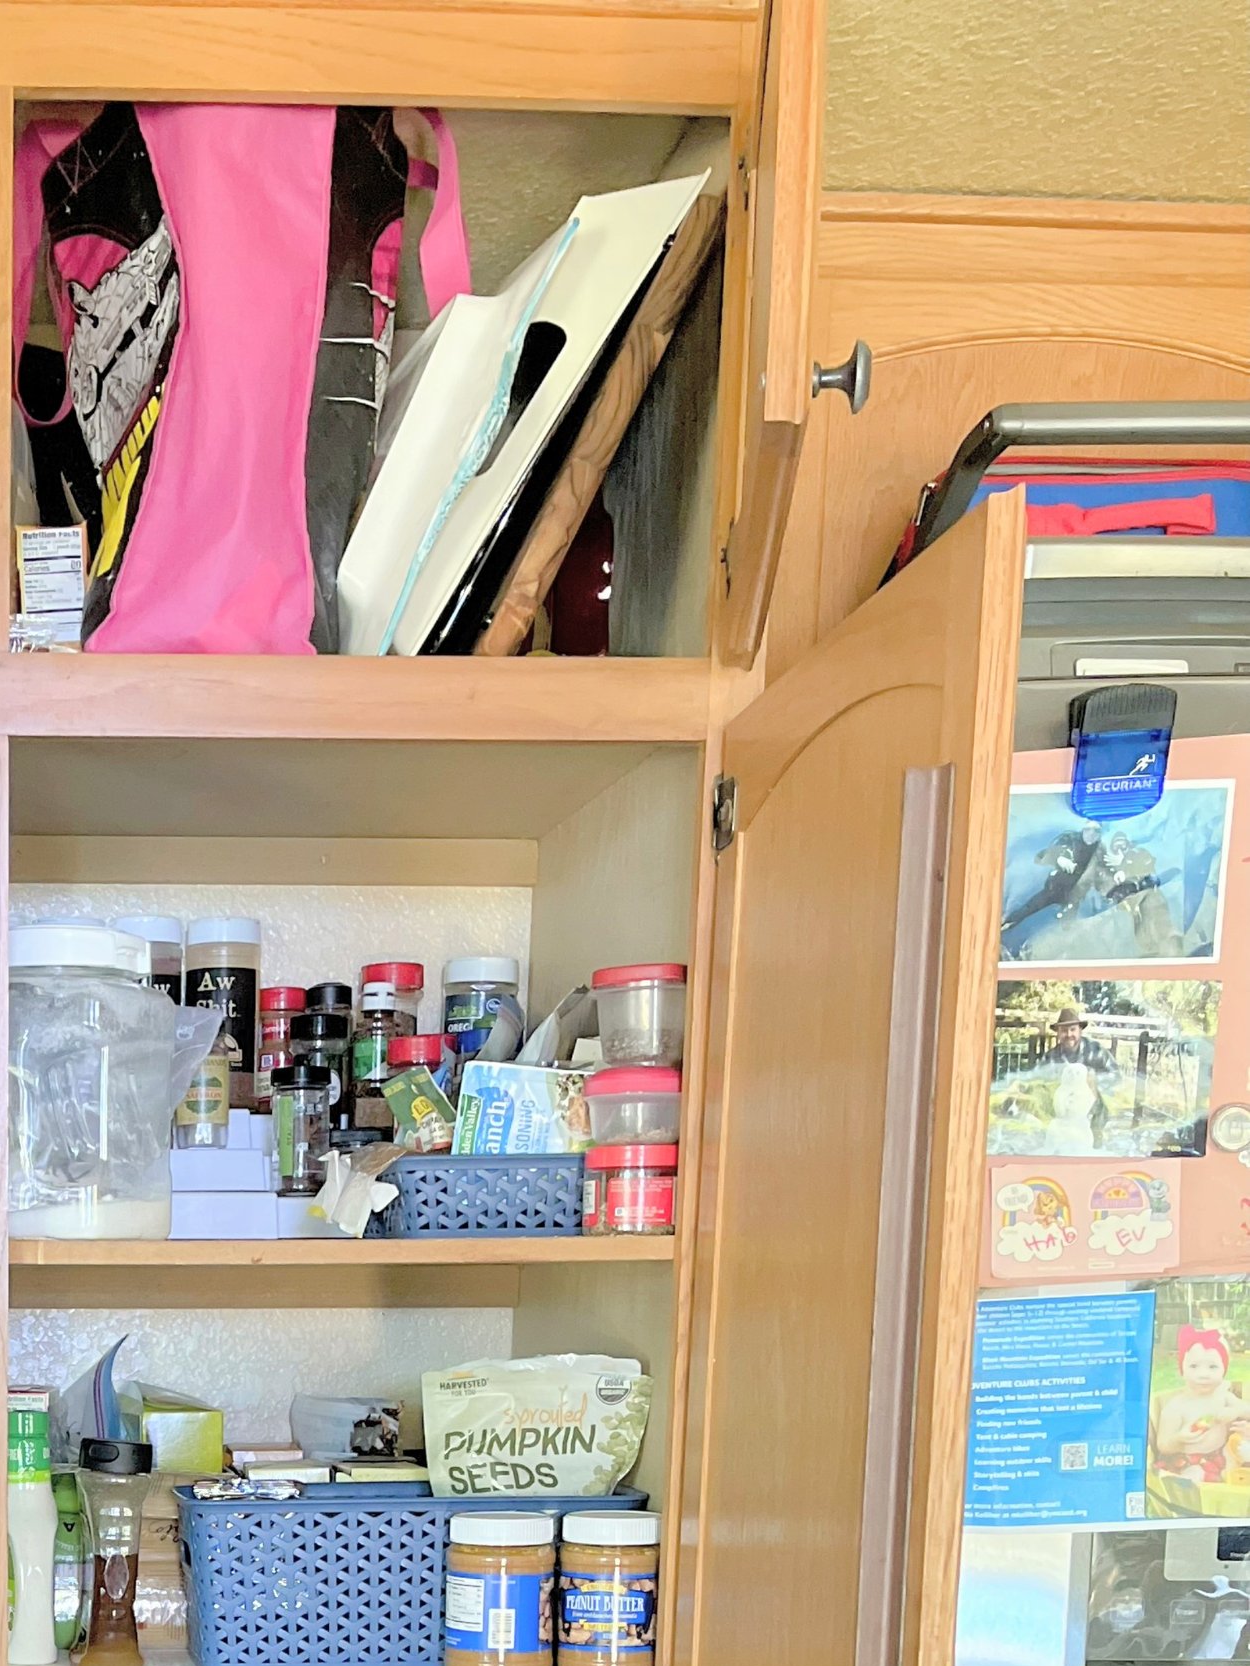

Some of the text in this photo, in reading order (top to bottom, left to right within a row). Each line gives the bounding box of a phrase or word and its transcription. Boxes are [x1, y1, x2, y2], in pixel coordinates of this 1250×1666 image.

[1086, 780, 1152, 793] SECURIAN
[197, 971, 236, 992] Aw
[465, 1098, 480, 1130] Valley
[486, 1101, 508, 1154] anch
[515, 1100, 536, 1150] SONING
[439, 1379, 487, 1391] HARVESTED
[1014, 1376, 1086, 1387] CLUBS ACTIVITIES
[503, 1393, 588, 1428] sprouted
[443, 1424, 596, 1460] PUMPKIN
[1097, 1444, 1130, 1454] LEARN
[1093, 1454, 1134, 1467] MORE!
[450, 1462, 559, 1495] SEEDS
[566, 1595, 644, 1612] PEANUT BUTTER
